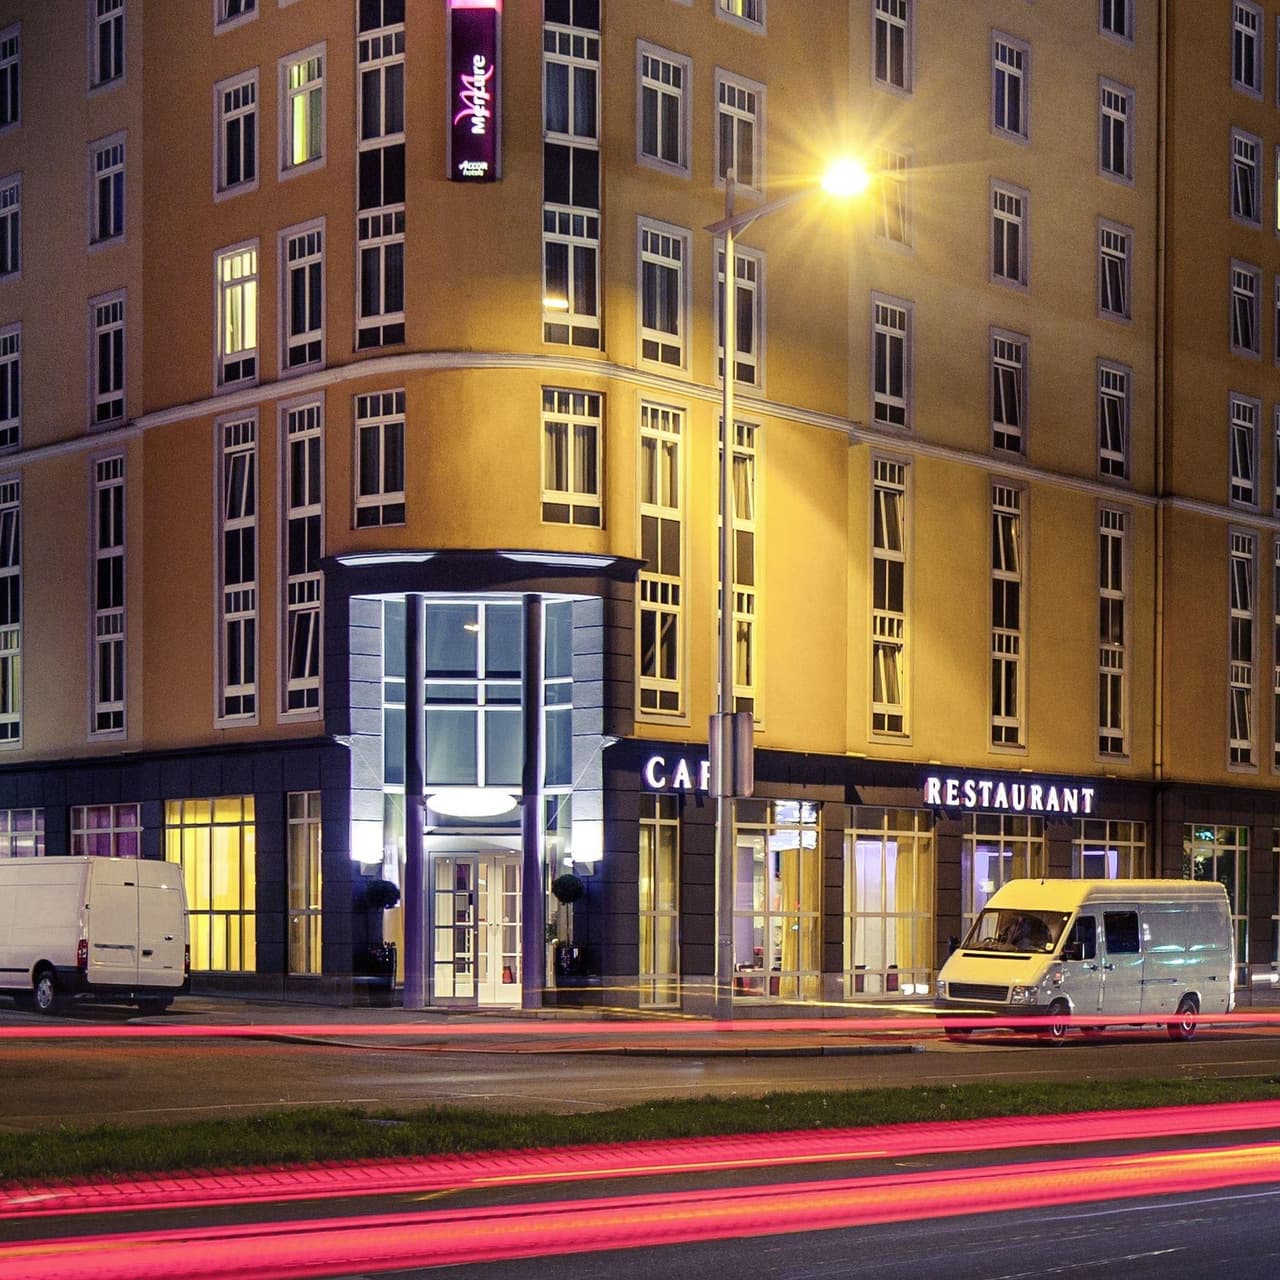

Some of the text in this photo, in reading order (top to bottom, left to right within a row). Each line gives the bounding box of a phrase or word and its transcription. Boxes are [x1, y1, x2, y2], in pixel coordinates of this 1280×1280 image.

[470, 54, 487, 135] Mercure
[645, 755, 711, 791] CAF
[924, 777, 1095, 814] RESTAURANT
